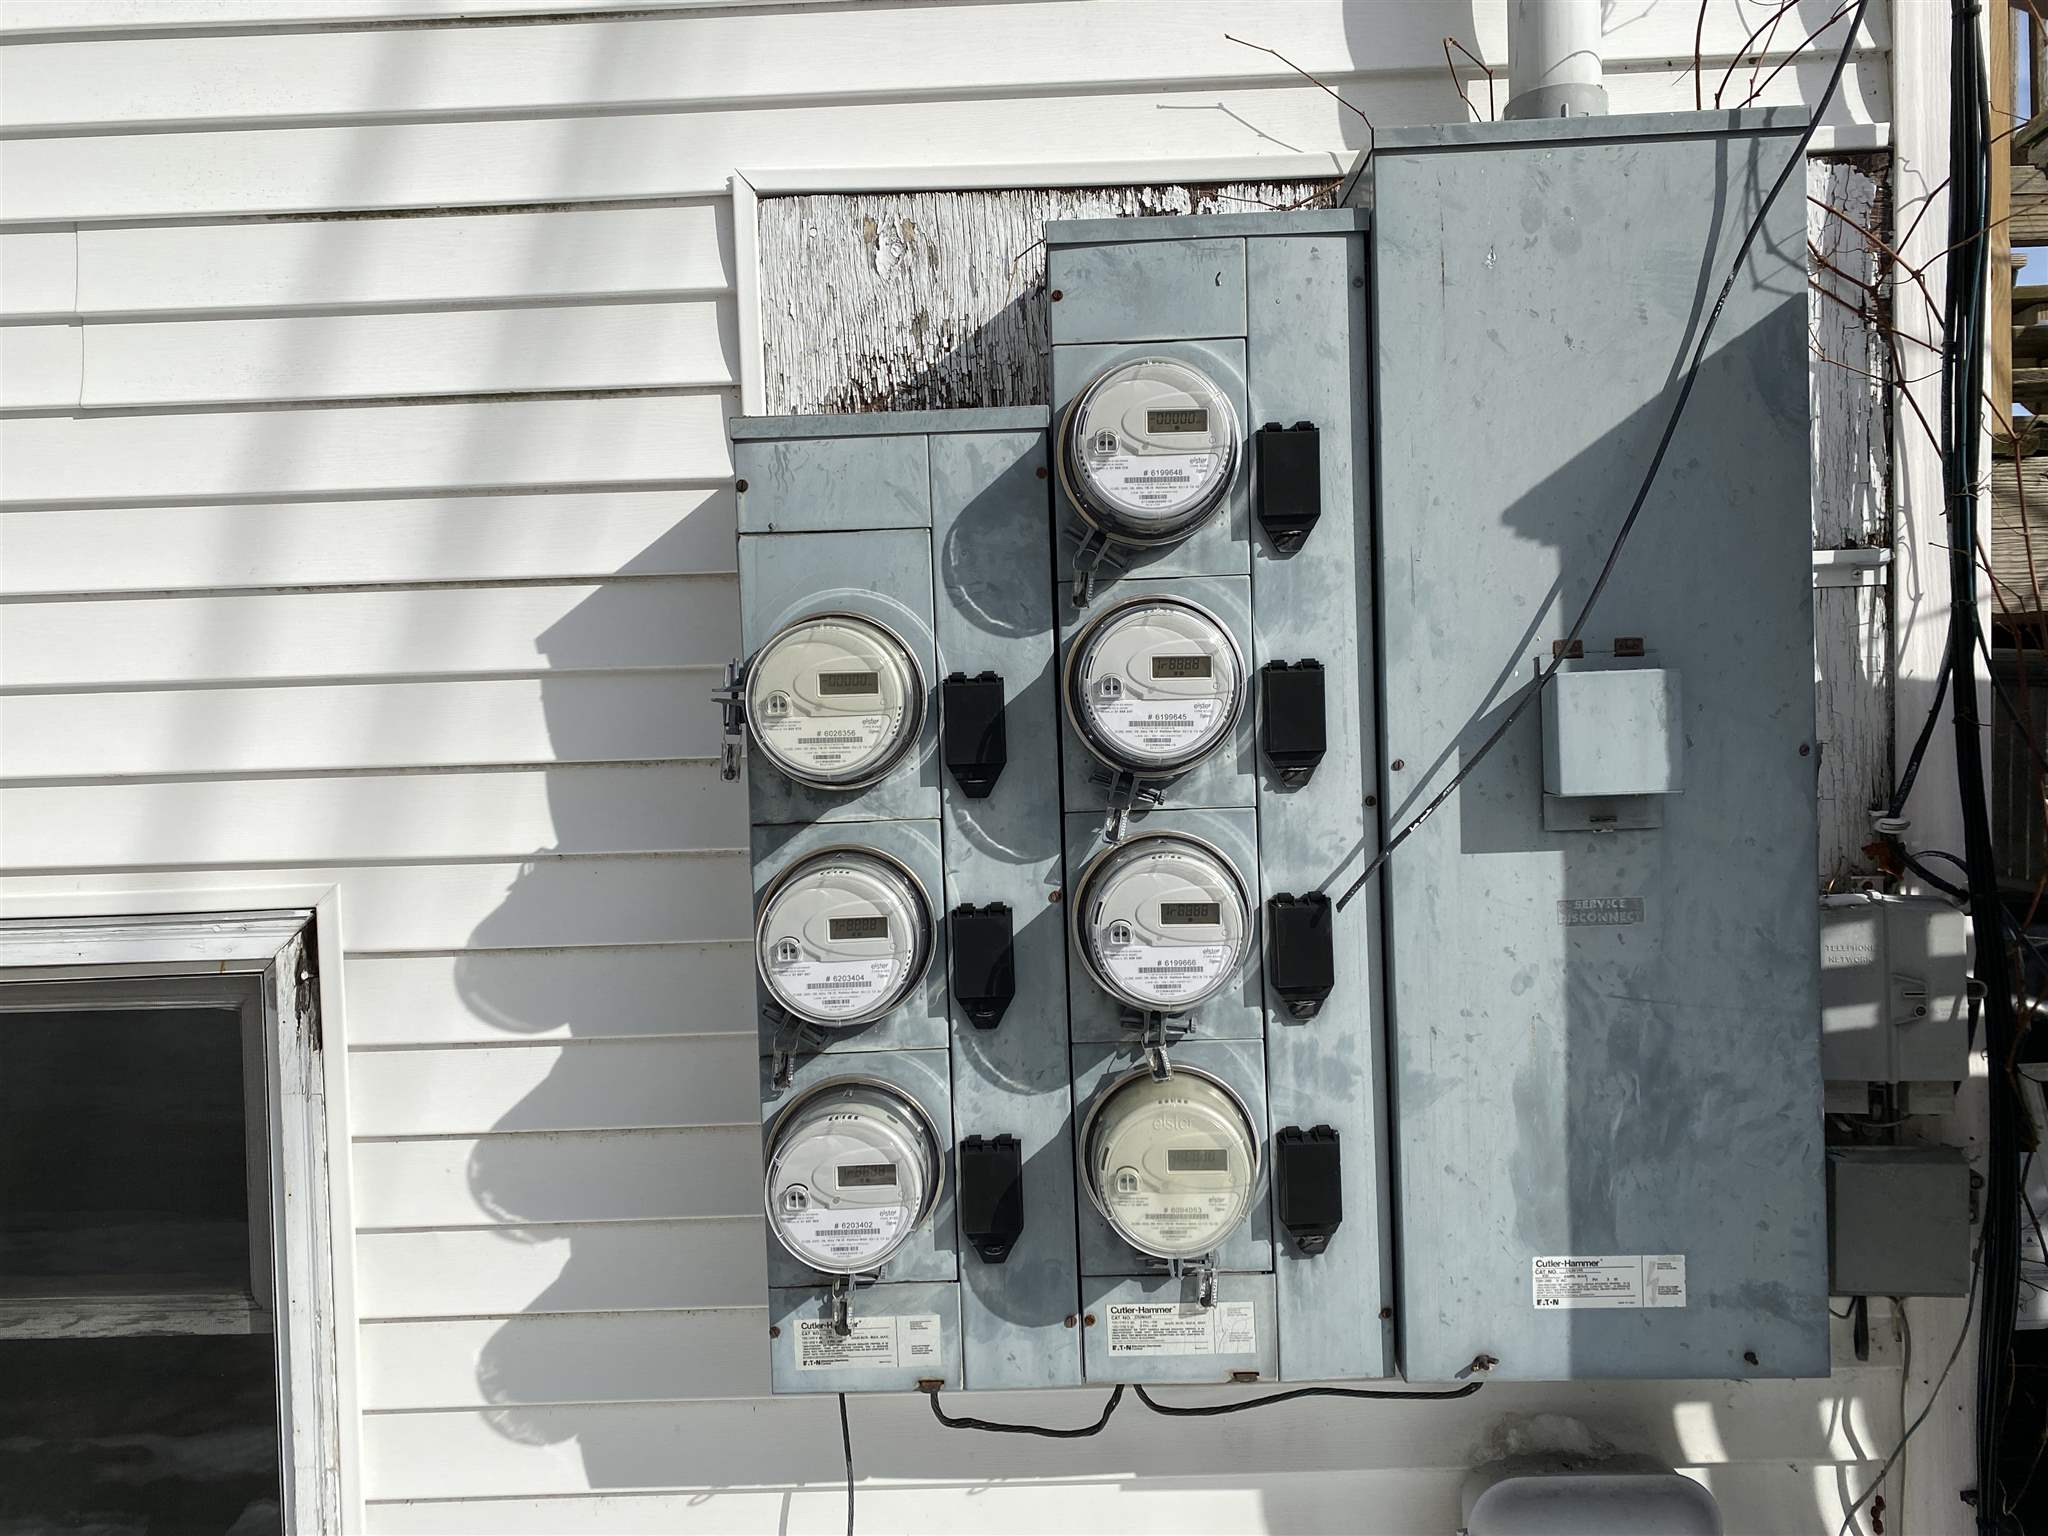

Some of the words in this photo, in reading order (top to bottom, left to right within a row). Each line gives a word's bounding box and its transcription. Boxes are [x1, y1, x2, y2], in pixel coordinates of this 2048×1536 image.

[1575, 899, 1625, 909] SERVICE
[841, 1221, 873, 1229] 6203402
[1535, 1259, 1599, 1268] Cutler-Hammer
[1110, 1306, 1172, 1314] Cutler-Hammer
